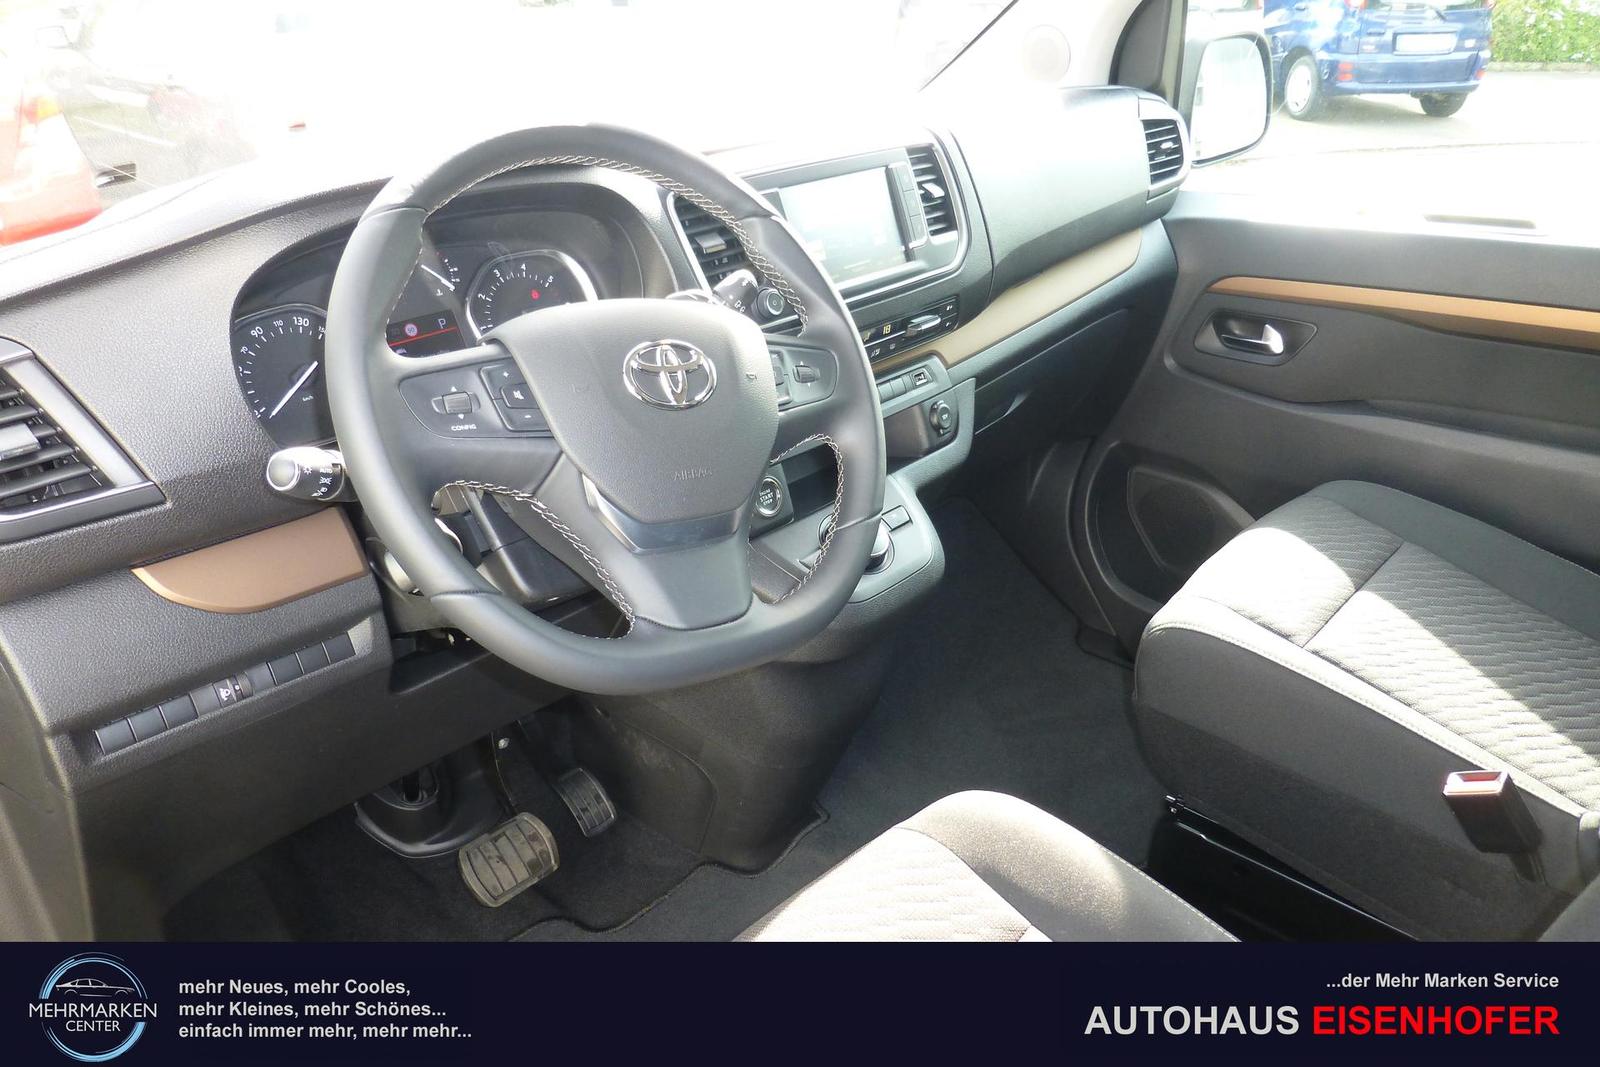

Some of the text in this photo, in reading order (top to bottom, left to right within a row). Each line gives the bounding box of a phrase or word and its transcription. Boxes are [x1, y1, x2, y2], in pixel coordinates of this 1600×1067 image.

[521, 263, 527, 271] 4
[493, 269, 501, 278] 3
[547, 275, 555, 283] 5
[273, 319, 284, 328] 110
[292, 316, 310, 327] 130
[438, 318, 446, 329] P
[250, 326, 264, 338] 90
[318, 326, 327, 334] 15
[882, 324, 892, 335] 18
[450, 423, 477, 432] CONFIG
[759, 492, 775, 503] START
